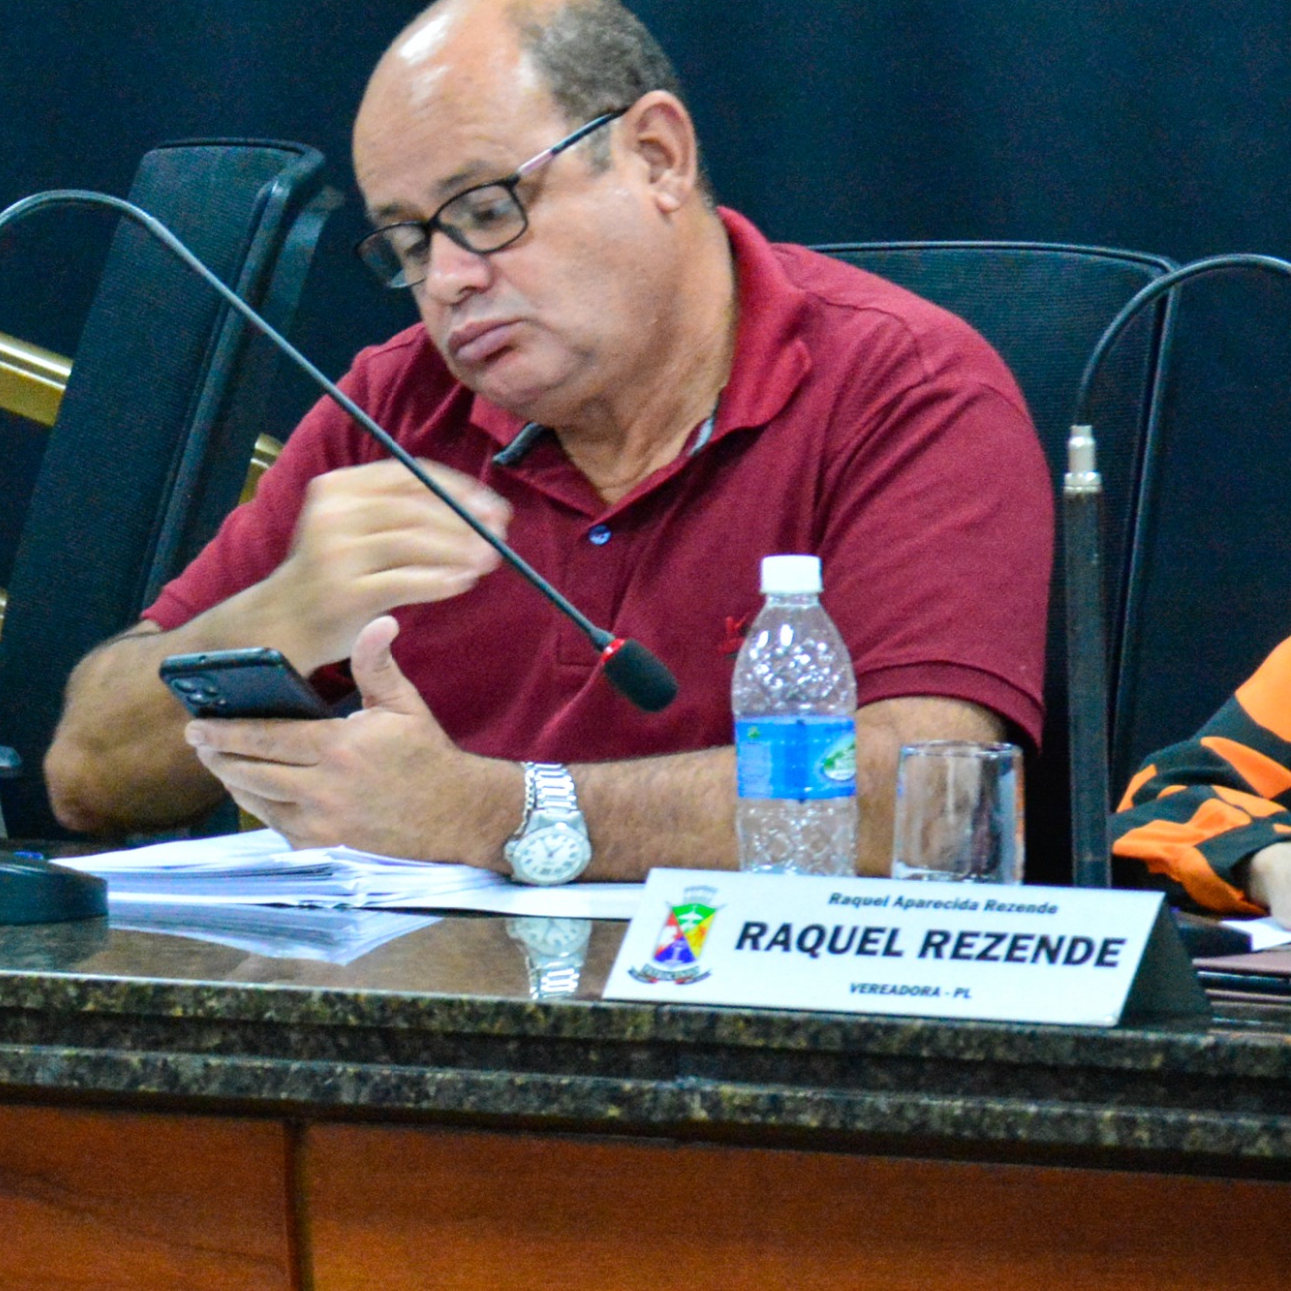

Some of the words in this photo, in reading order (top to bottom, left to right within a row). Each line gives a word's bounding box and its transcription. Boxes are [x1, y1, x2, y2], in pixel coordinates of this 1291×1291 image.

[828, 892, 890, 909] Raquel
[893, 895, 979, 911] Aparecida
[983, 899, 1059, 915] Rezende
[734, 920, 904, 960] RAQUEL
[917, 929, 1126, 968] REZENDE
[849, 982, 941, 998] VEREADORA
[952, 987, 972, 999] PL
